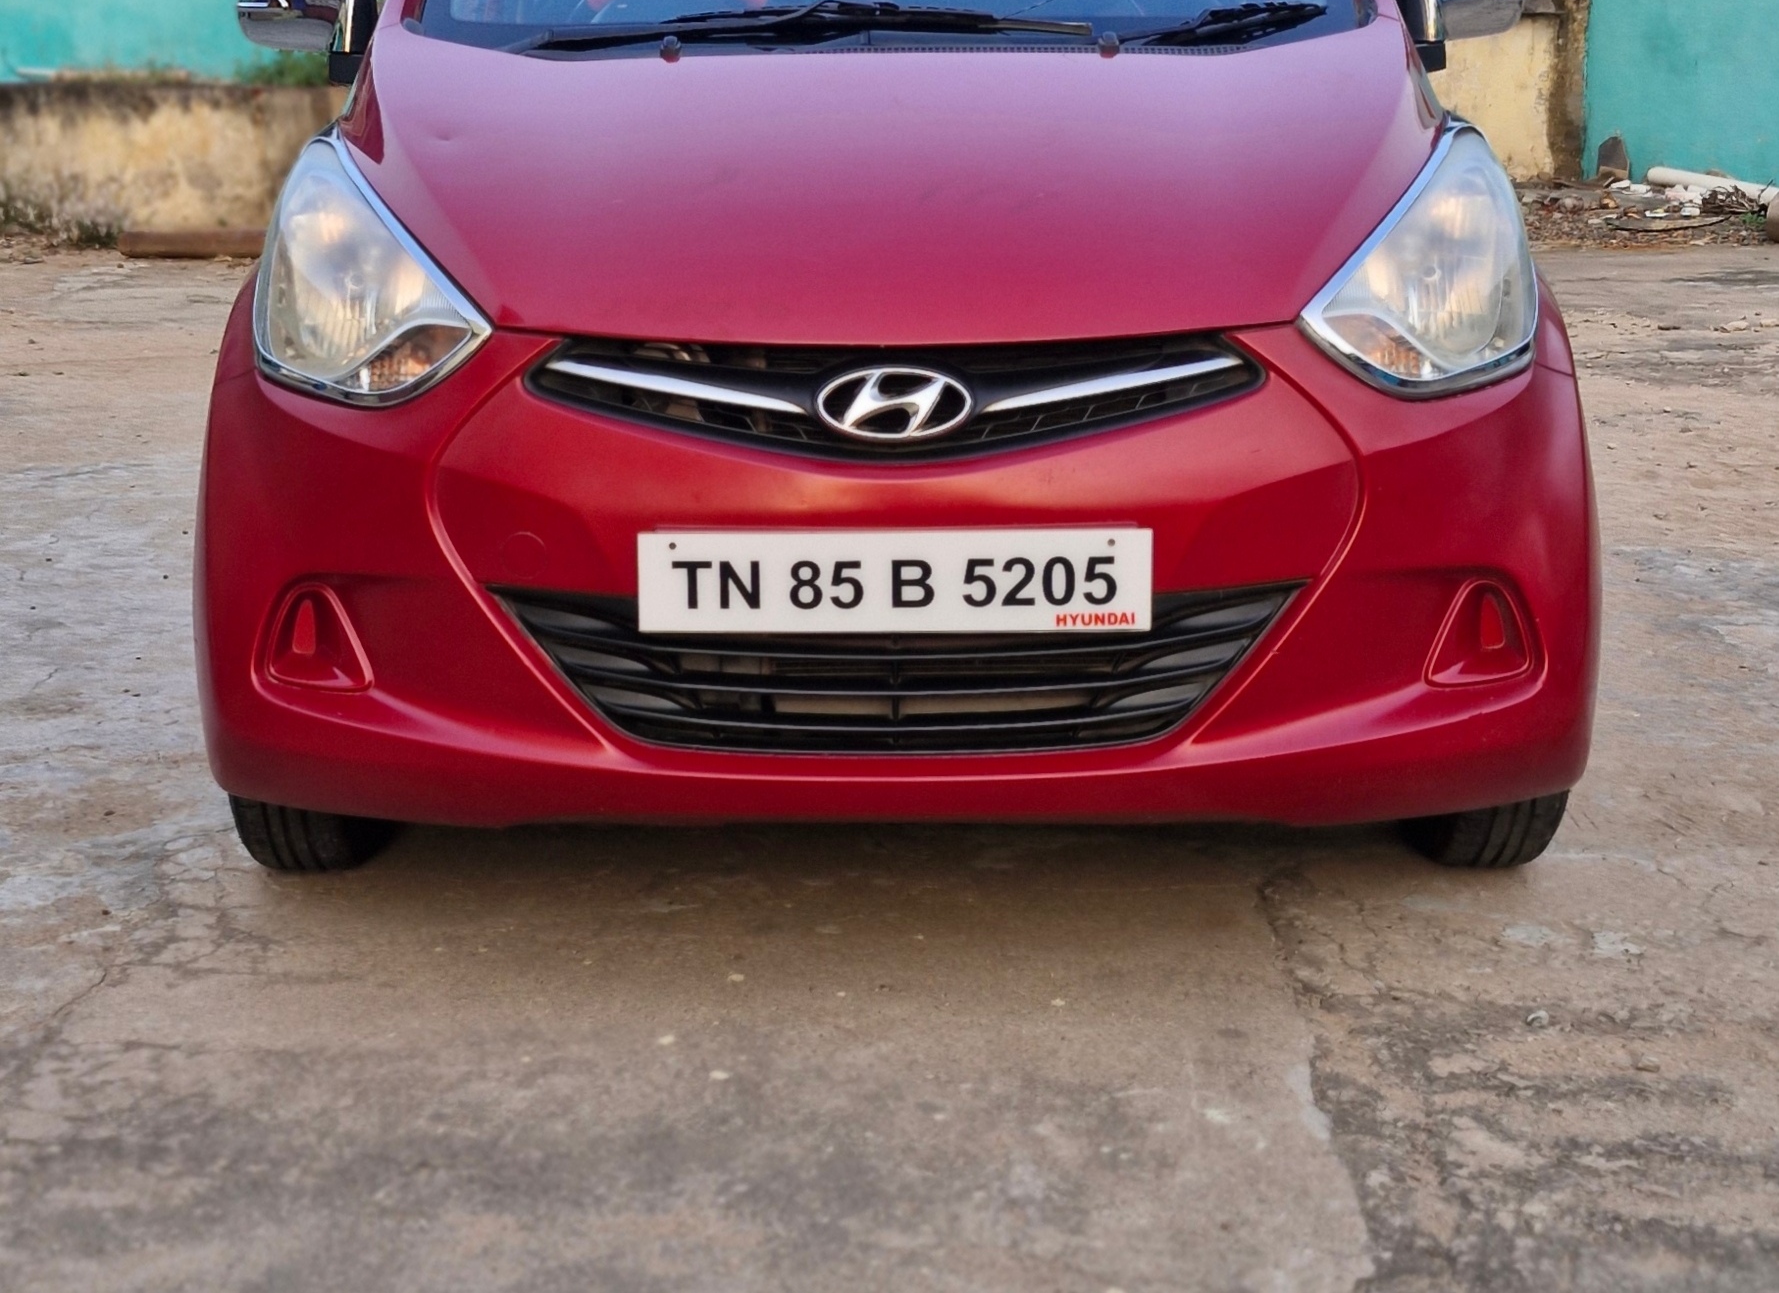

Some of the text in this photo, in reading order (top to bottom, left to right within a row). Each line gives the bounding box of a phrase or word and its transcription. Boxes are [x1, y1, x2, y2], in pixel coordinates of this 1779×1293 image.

[671, 555, 1118, 610] TN 85 B 5205
[1054, 611, 1136, 627] HYUNDAI
